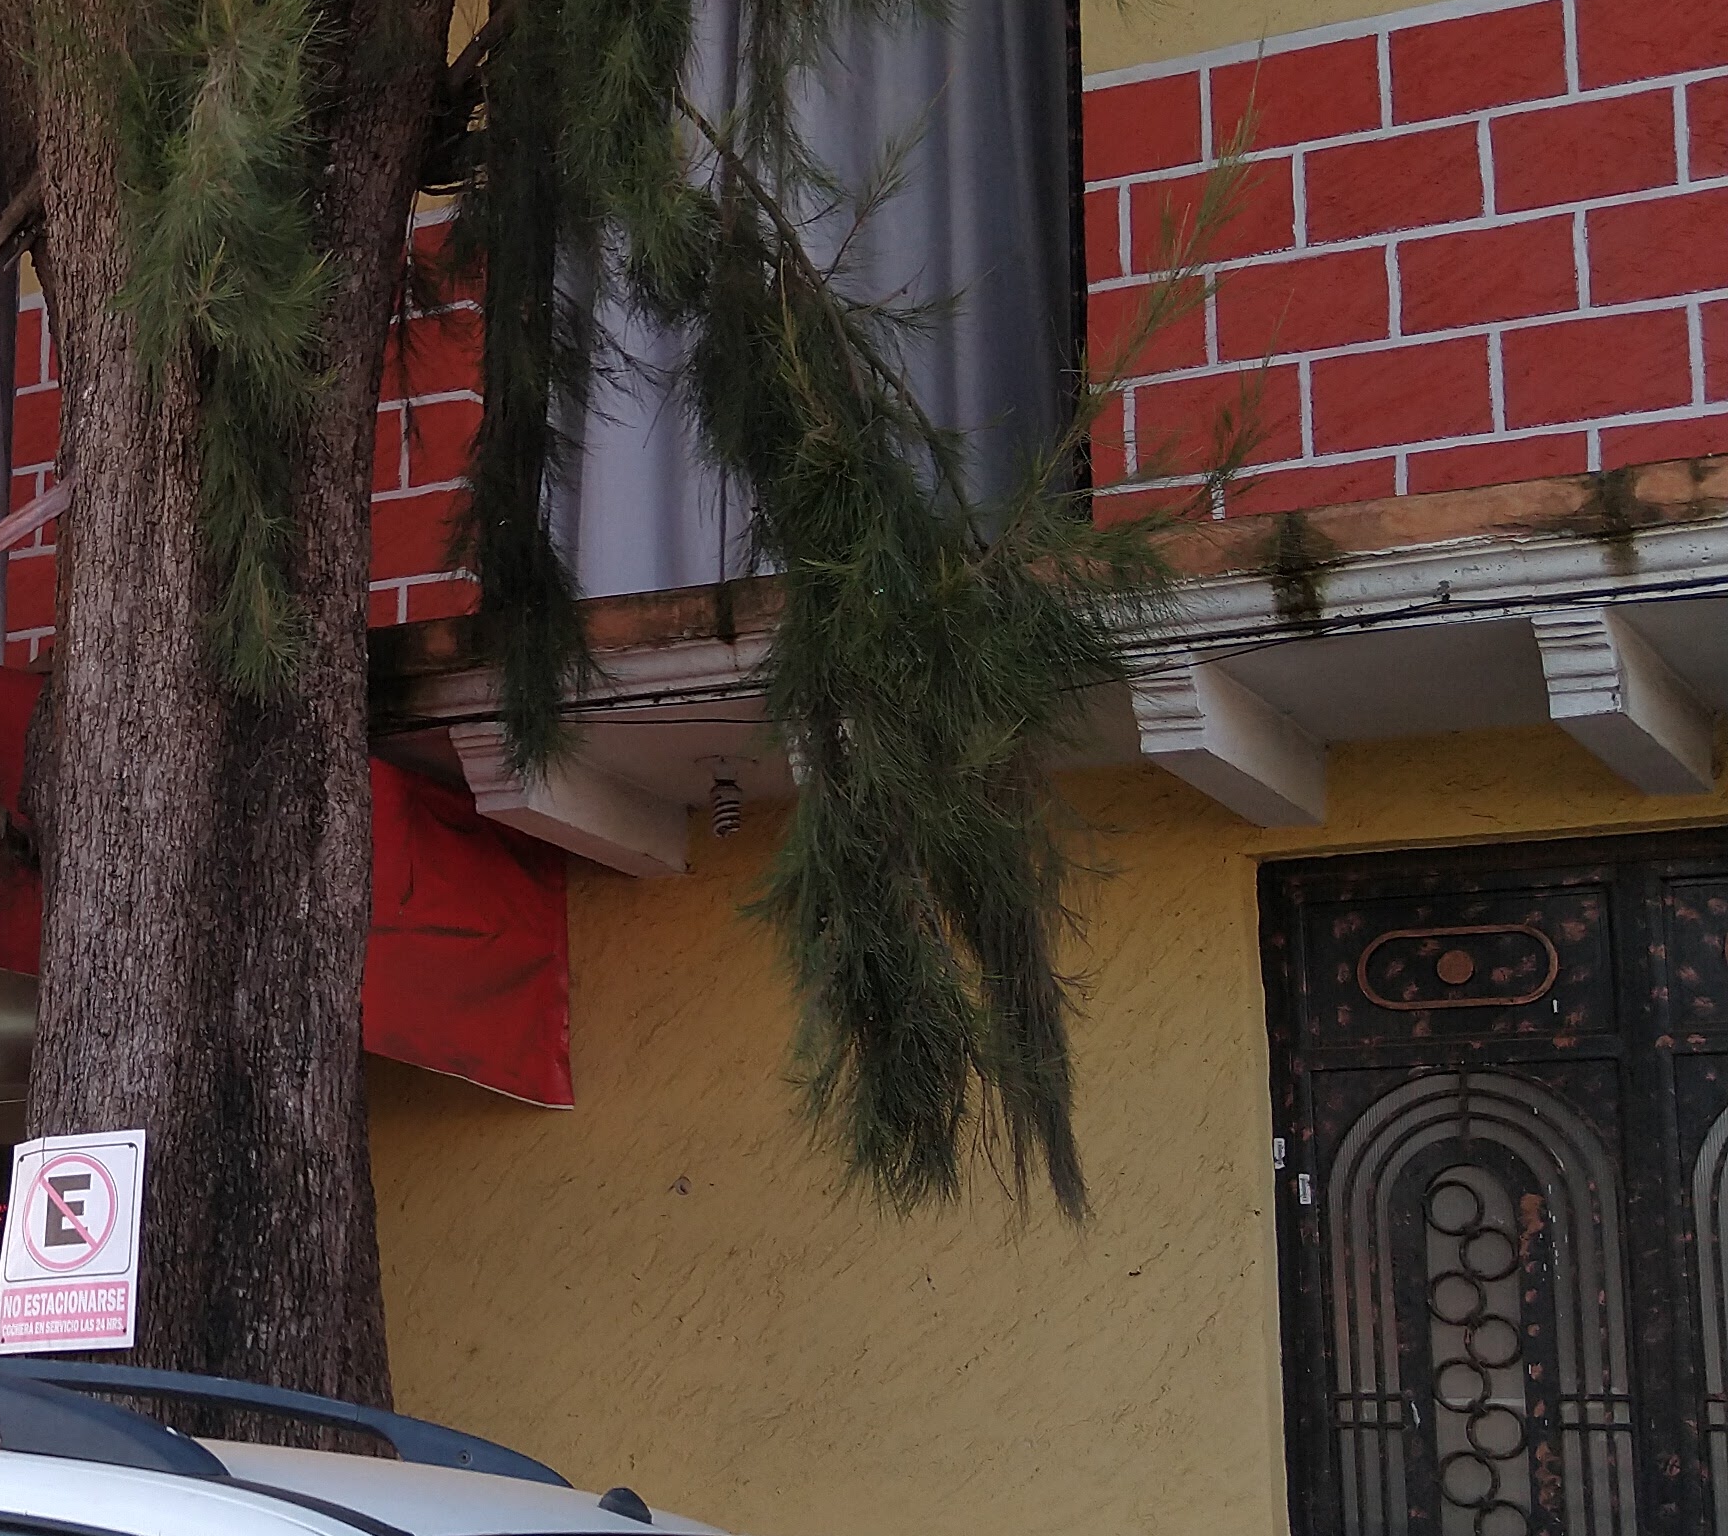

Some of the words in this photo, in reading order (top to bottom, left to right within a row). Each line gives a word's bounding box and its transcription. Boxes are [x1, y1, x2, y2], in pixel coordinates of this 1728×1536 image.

[44, 1173, 92, 1248] E
[3, 1294, 22, 1319] NO
[23, 1287, 126, 1317] ESTACIONARSE
[35, 1321, 45, 1335] EN
[45, 1318, 79, 1335] SERVICIO
[80, 1318, 95, 1332] LAS
[96, 1317, 105, 1331] 24
